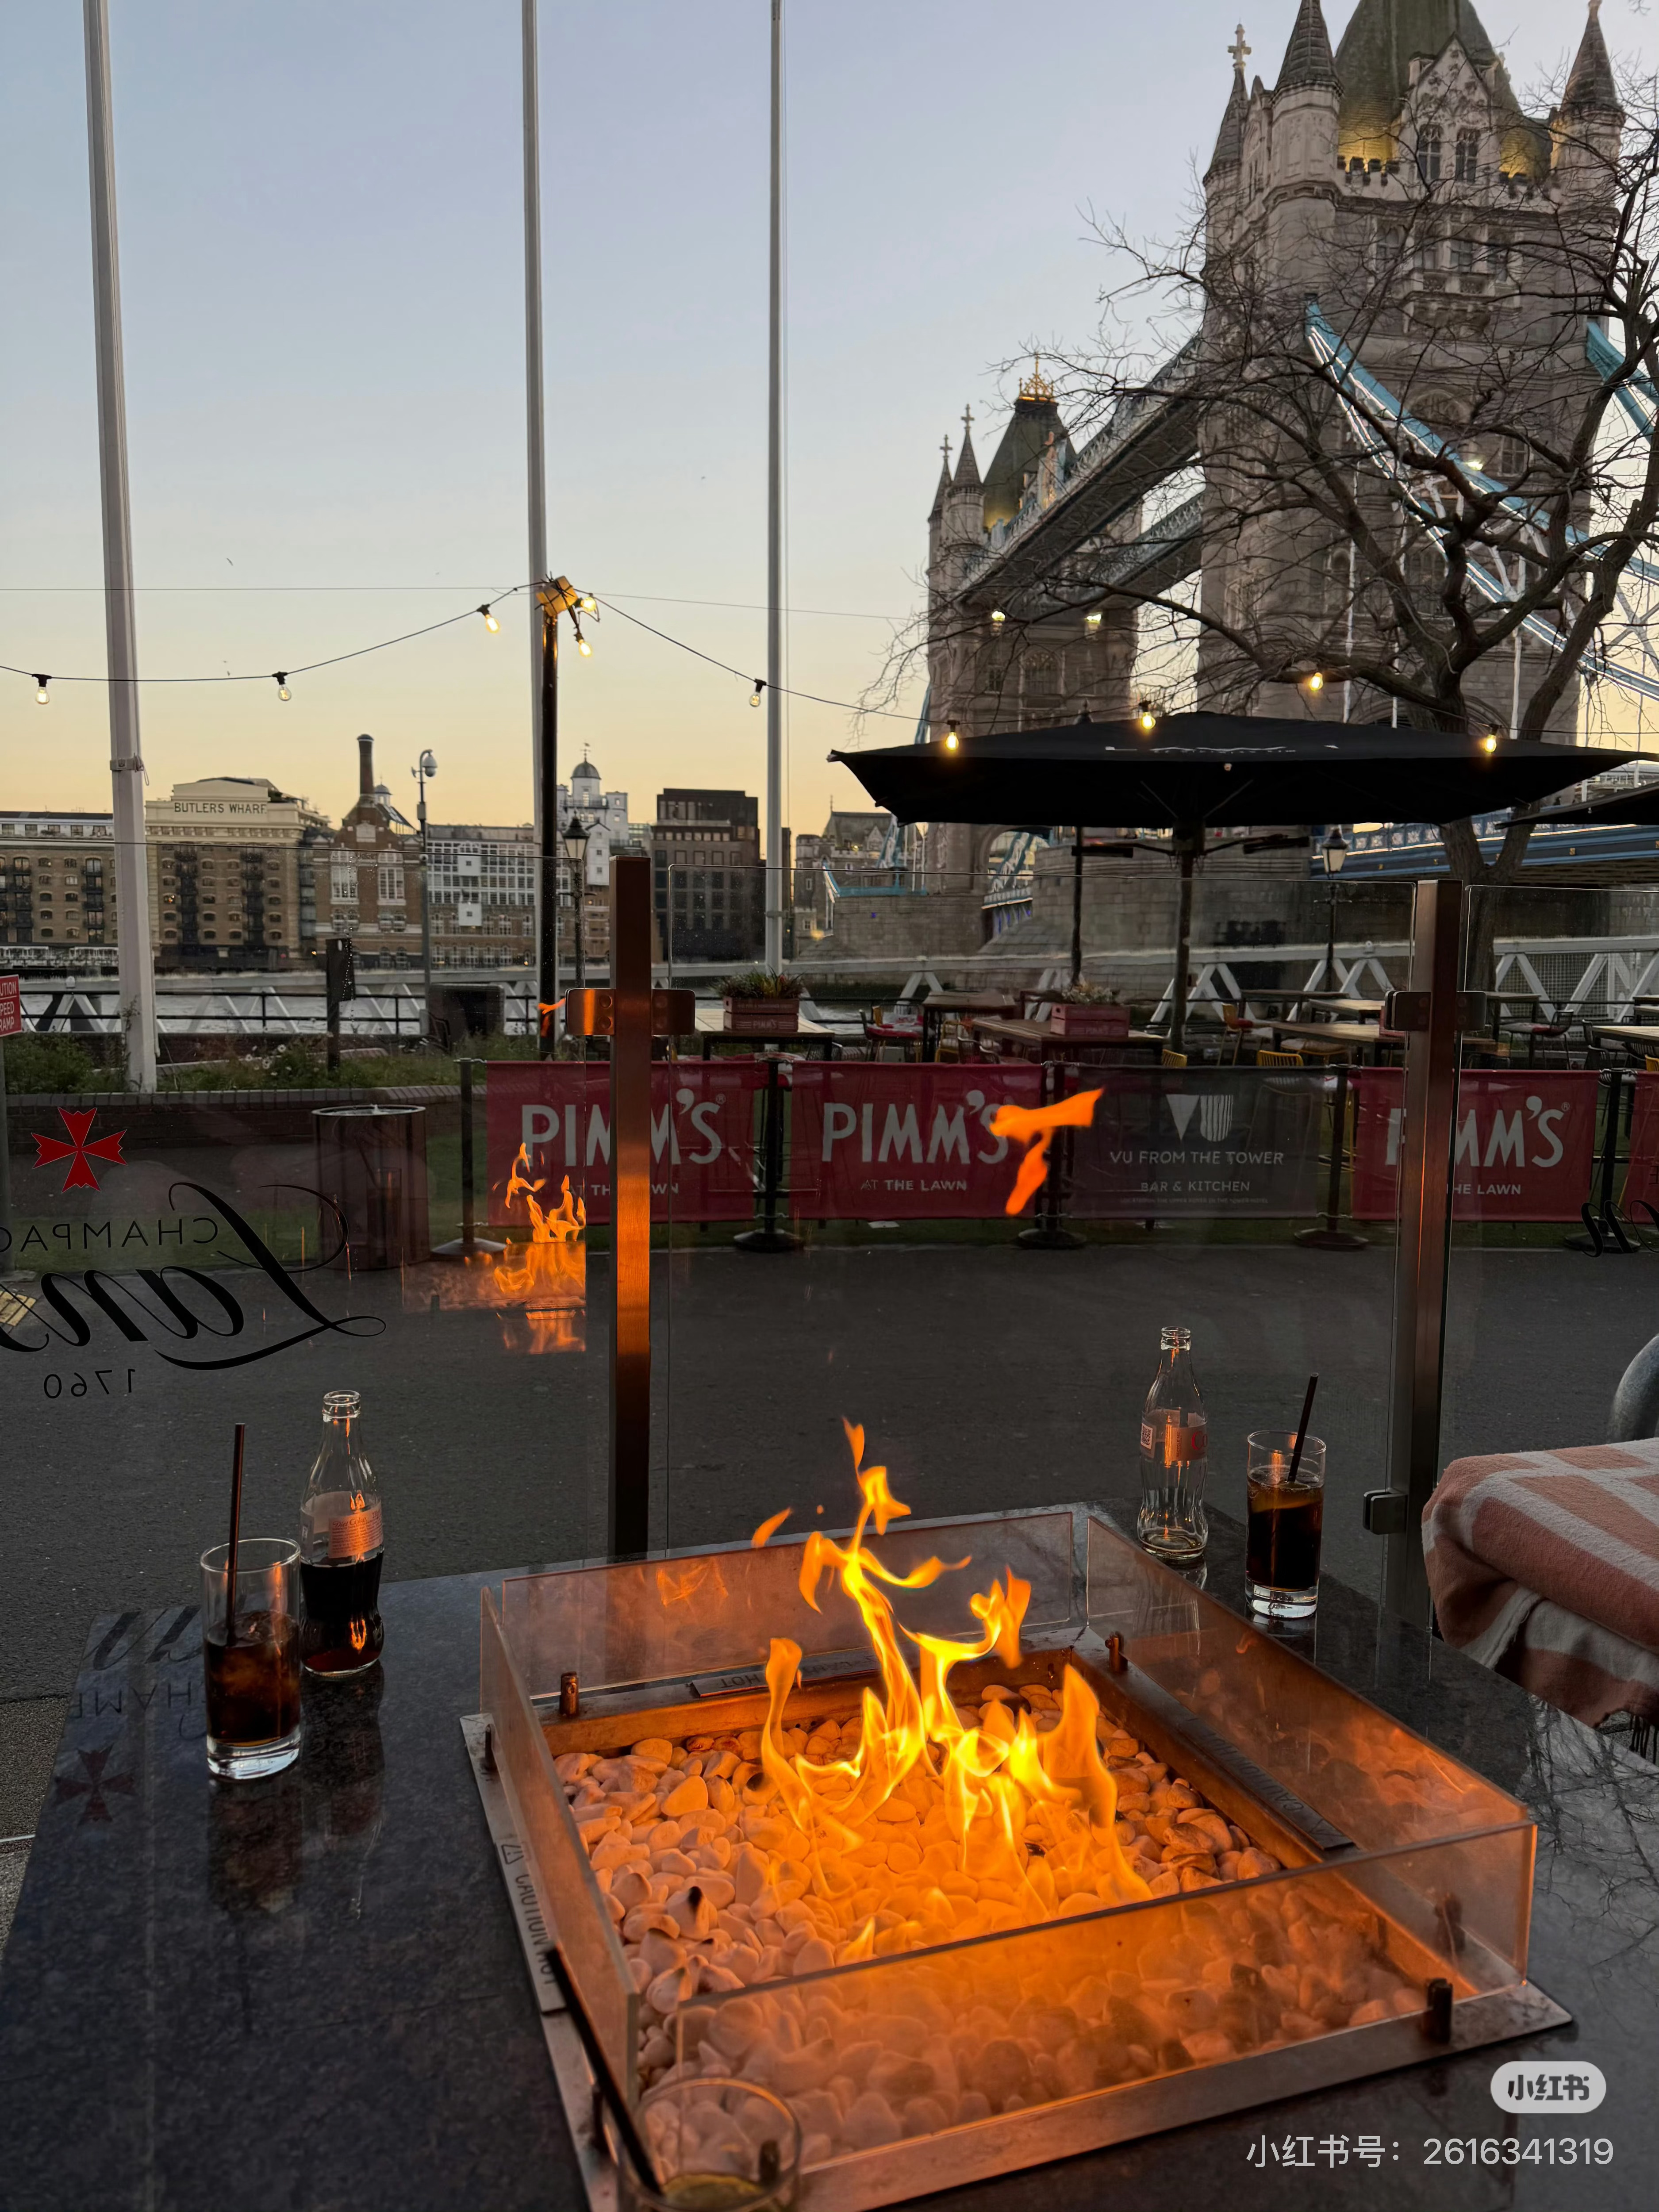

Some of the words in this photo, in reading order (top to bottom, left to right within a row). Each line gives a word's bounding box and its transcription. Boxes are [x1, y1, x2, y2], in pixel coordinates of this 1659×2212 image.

[174, 802, 224, 813] BUTLERS
[229, 803, 267, 814] WHARF
[1110, 1151, 1133, 1164] VU
[1139, 1151, 1185, 1164] FROM
[1190, 1151, 1221, 1164] THE
[1225, 1151, 1284, 1164] TOWER
[861, 1179, 878, 1190] AT
[885, 1179, 914, 1191] THE
[920, 1179, 967, 1191] LAWN
[1141, 1181, 1168, 1192] BAR
[1173, 1181, 1182, 1191] &
[1188, 1181, 1250, 1192] KITCHEN
[1477, 1184, 1521, 1195] LAWN
[349, 1517, 367, 1526] Coke
[1230, 1757, 1305, 1812] CAUTION
